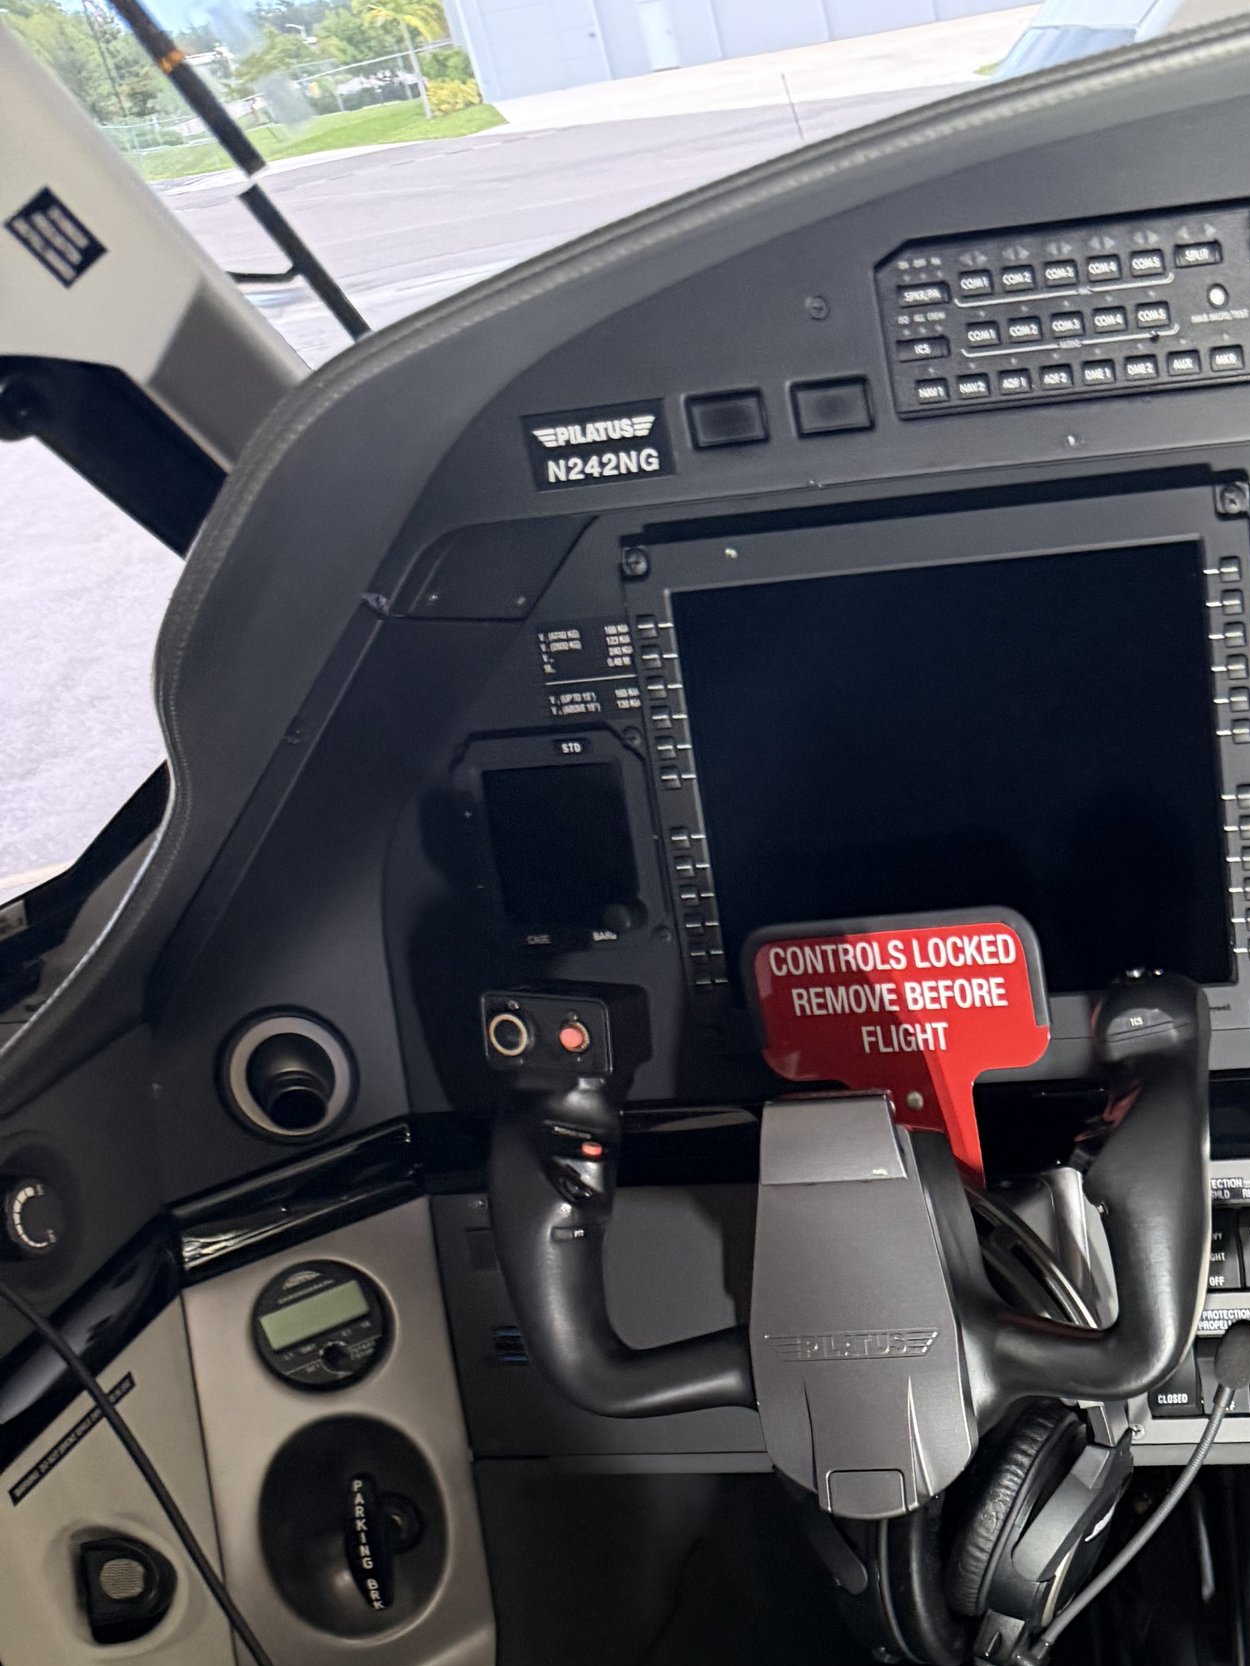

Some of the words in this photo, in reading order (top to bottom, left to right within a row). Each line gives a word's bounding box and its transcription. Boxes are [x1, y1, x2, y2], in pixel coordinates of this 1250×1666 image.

[555, 418, 634, 447] PILATUS
[547, 448, 660, 483] N242NG
[769, 939, 908, 976] CONTROLS
[912, 934, 1017, 969] LOCKED
[791, 983, 900, 1016] REMOVE
[904, 977, 1009, 1011] BEFORE
[861, 1022, 949, 1053] FLIGHT
[1157, 1394, 1188, 1404] CLOSED
[352, 1479, 374, 1570] PARKING
[366, 1578, 386, 1610] BRK
